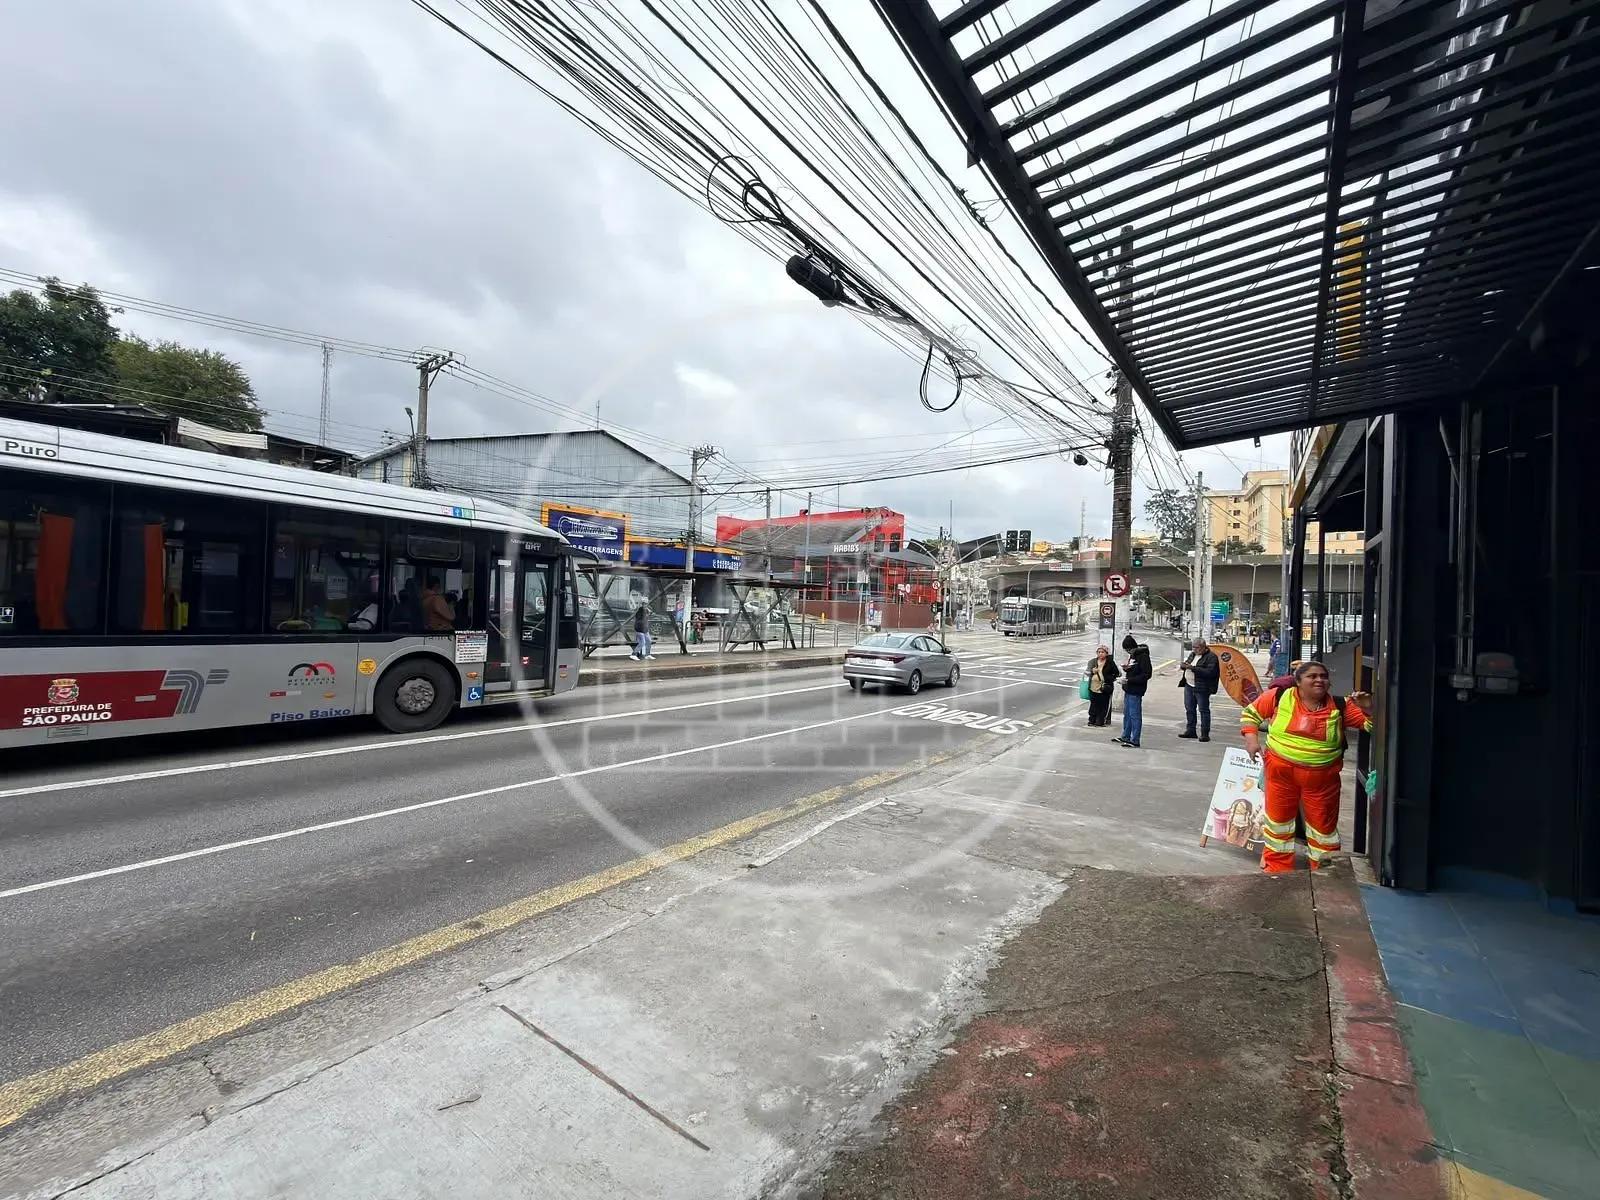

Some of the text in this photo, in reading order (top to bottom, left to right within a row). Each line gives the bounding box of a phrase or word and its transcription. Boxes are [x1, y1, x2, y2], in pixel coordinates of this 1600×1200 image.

[4, 440, 57, 458] Puro
[583, 545, 623, 556] FERRAGENS
[833, 543, 860, 553] HABIB'S
[23, 702, 112, 715] PREFEITURA DE
[270, 708, 351, 722] Piso Baixo
[22, 711, 112, 726] SÃO PAULO
[890, 701, 1034, 735] ÔNIBUS
[1246, 758, 1260, 766] BET
